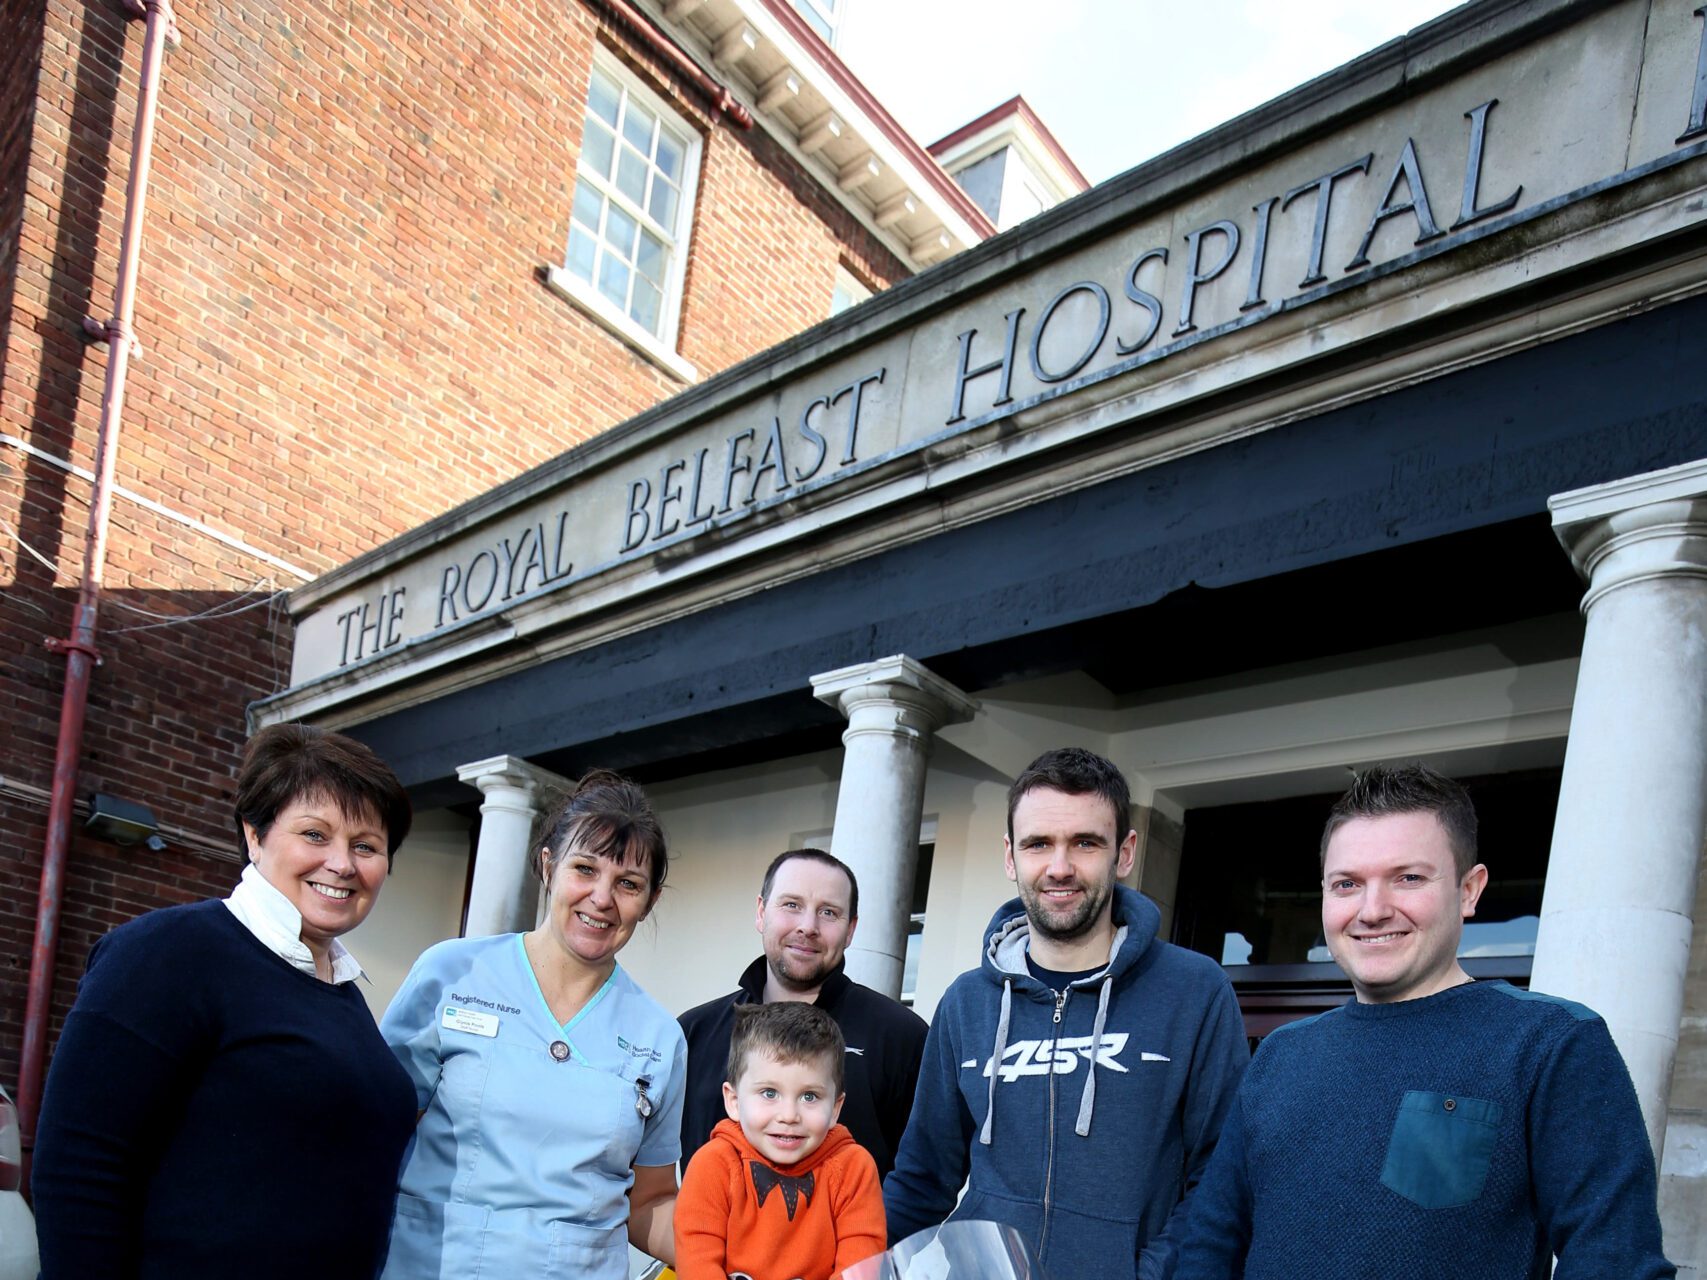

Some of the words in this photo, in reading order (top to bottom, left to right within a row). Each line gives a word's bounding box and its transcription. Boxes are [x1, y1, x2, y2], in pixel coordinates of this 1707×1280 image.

[336, 586, 407, 667] THE
[434, 511, 573, 629] ROYAL
[618, 366, 887, 554] BELFAST
[945, 98, 1524, 426] HOSPITAL
[451, 993, 495, 1010] Registered
[496, 1003, 521, 1015] Nurse
